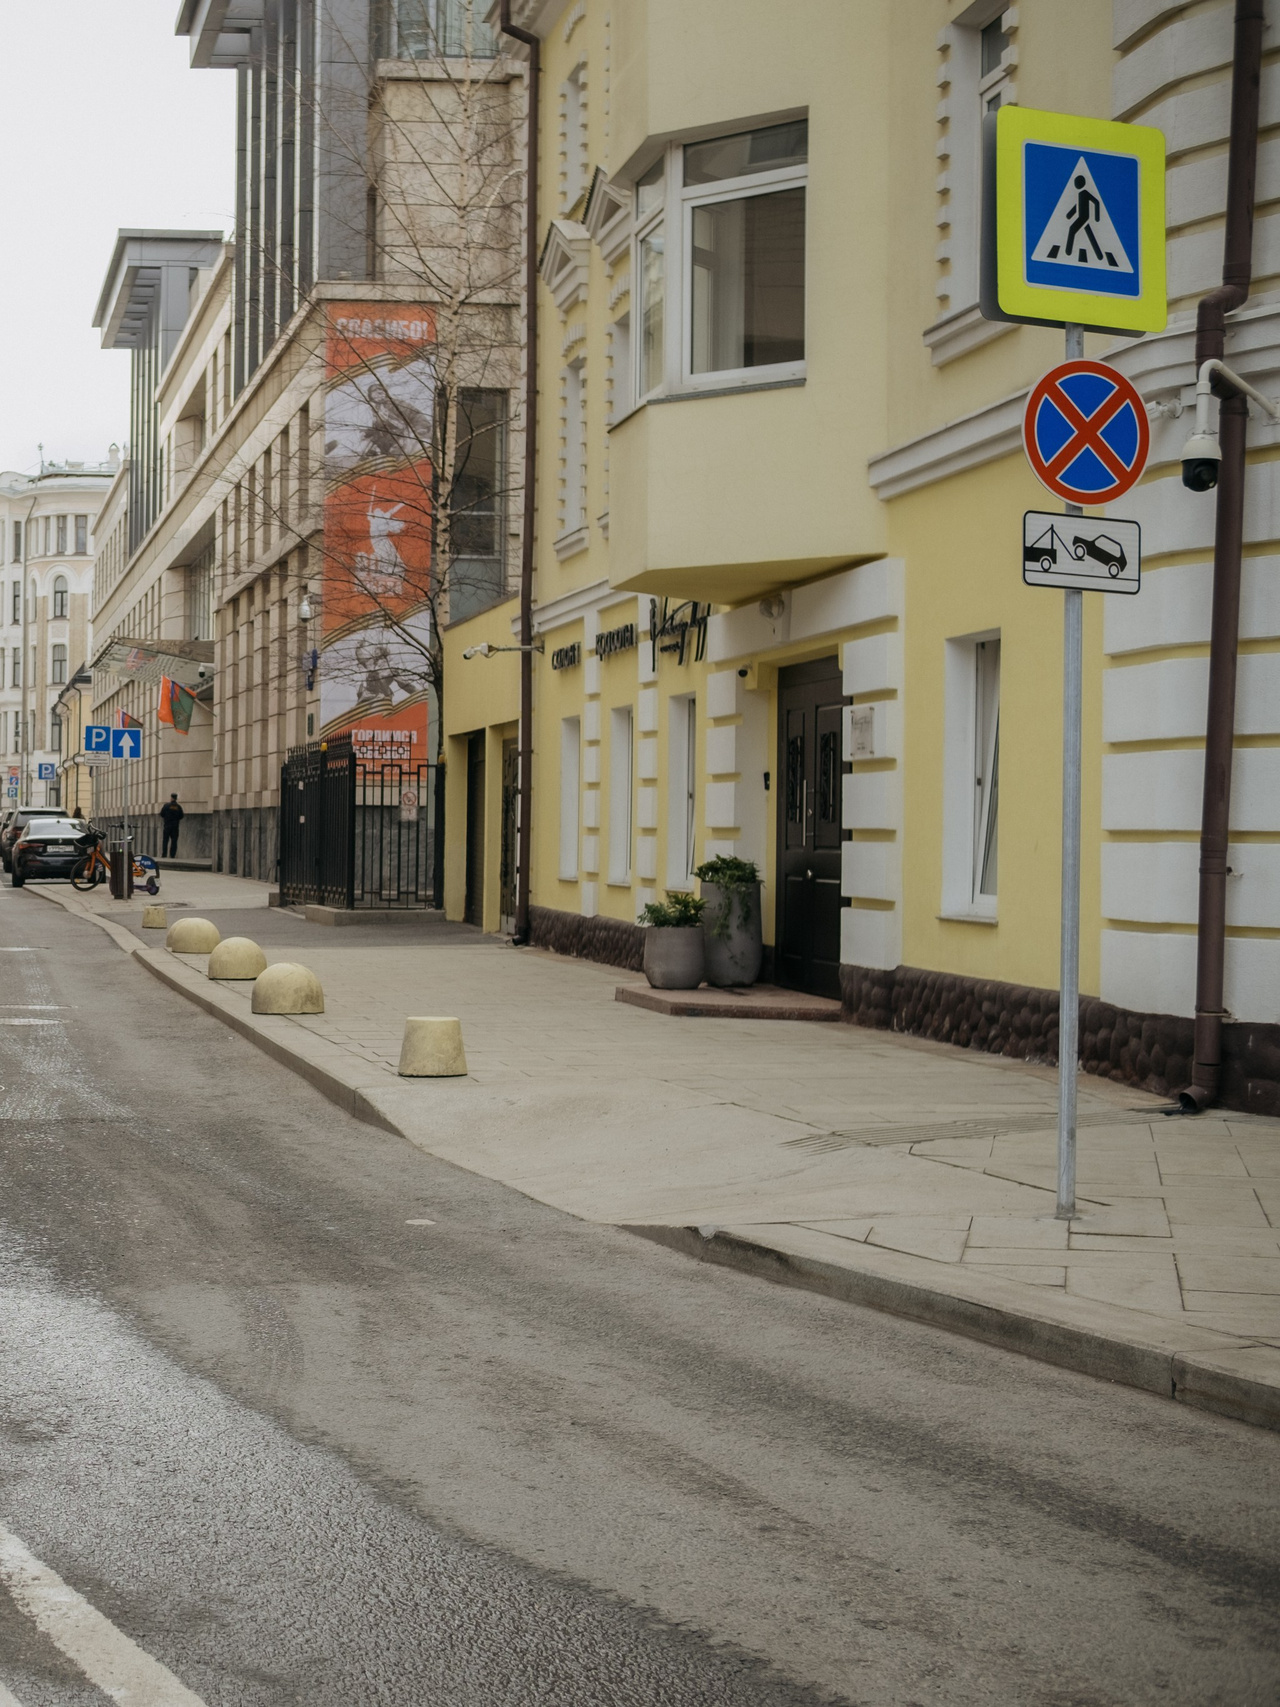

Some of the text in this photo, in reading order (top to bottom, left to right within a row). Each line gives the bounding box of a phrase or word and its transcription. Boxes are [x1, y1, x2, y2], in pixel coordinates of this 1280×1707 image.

[336, 318, 428, 340] СПАСИБО!
[91, 728, 107, 749] P
[352, 729, 417, 745] ГОРДИМСЯ
[42, 764, 52, 778] P
